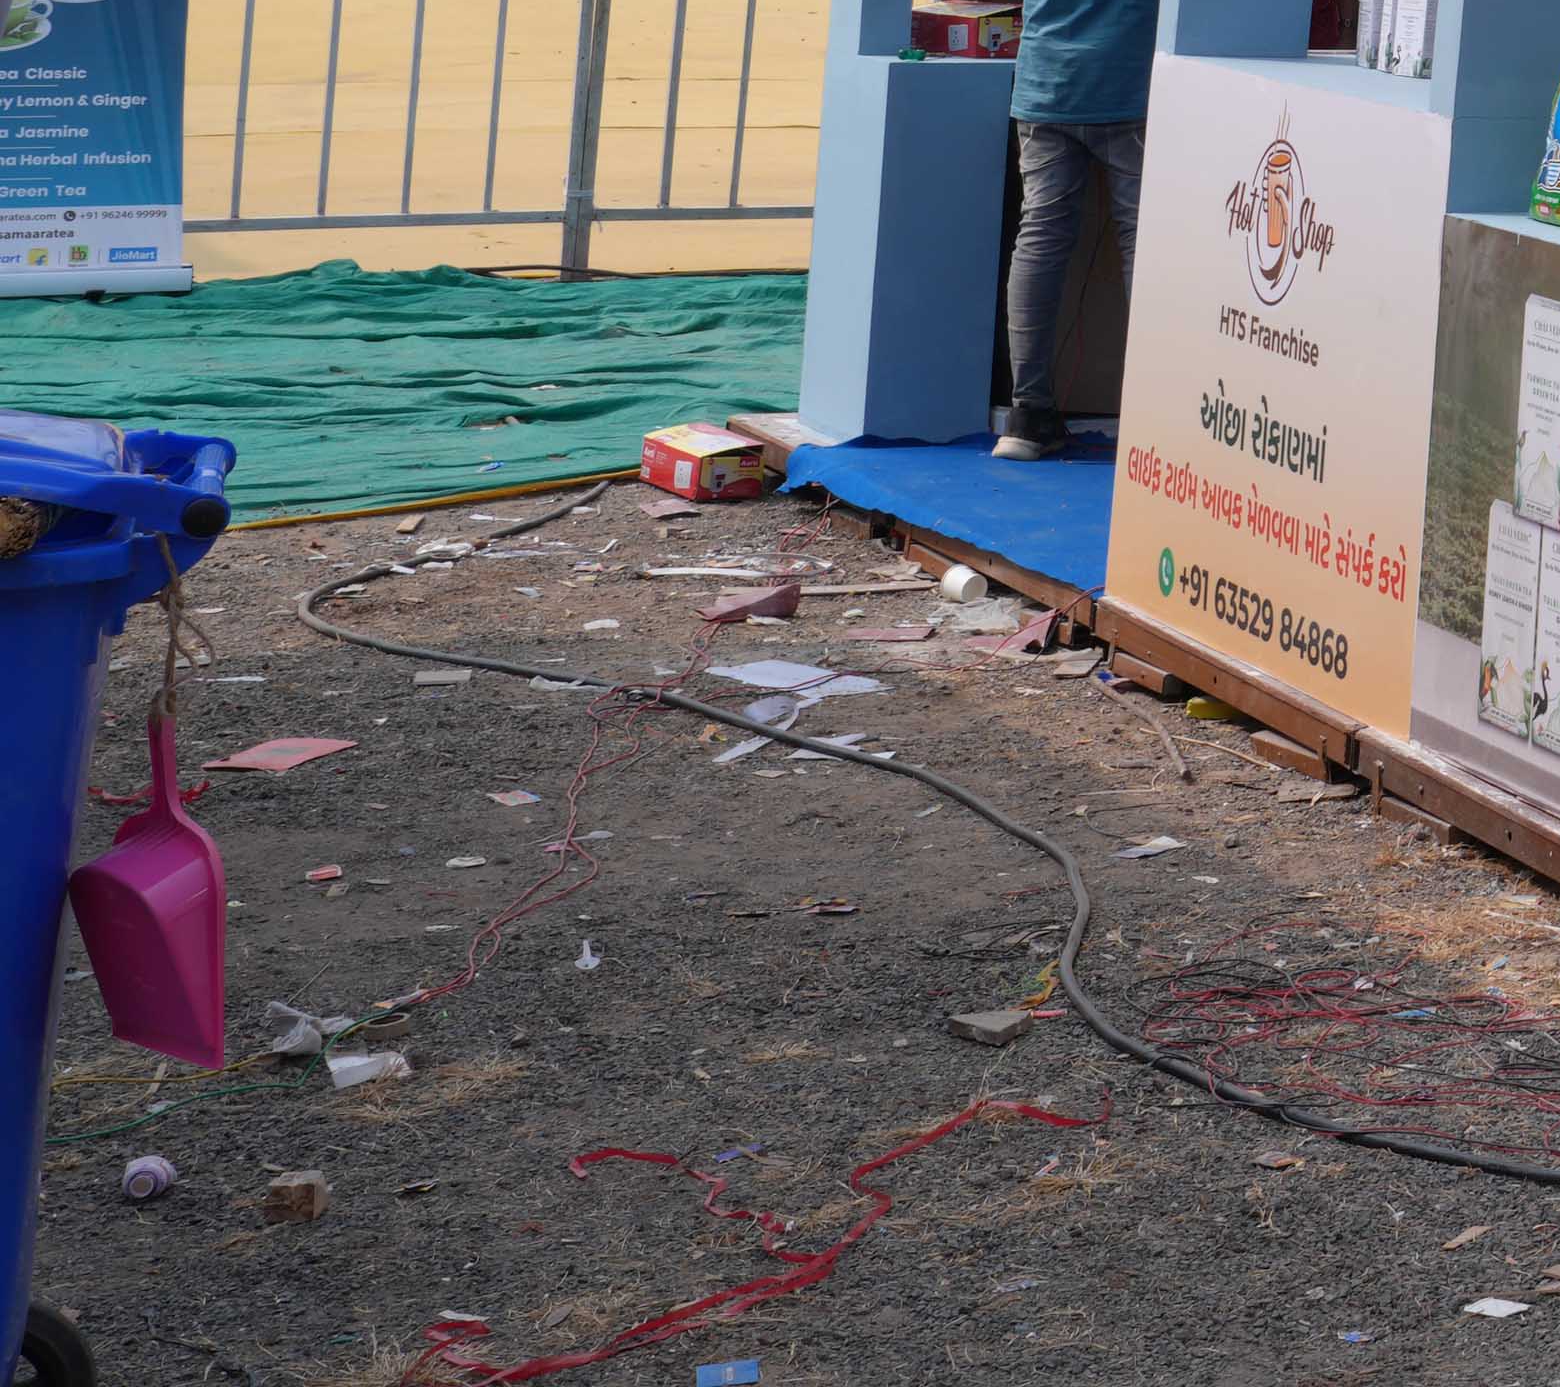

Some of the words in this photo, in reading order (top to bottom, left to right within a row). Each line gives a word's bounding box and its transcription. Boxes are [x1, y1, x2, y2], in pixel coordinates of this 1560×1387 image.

[25, 66, 88, 80] Classic
[16, 94, 74, 107] Lemon
[92, 93, 148, 110] Ginger
[15, 124, 89, 139] Jasmine
[19, 152, 78, 166] Herbal
[83, 150, 152, 165] Infusion
[55, 184, 87, 197] Tea
[101, 210, 134, 220] 96246
[136, 209, 168, 219] 99999
[1225, 180, 1260, 241] Hot
[1292, 196, 1336, 273] Shop
[111, 249, 156, 261] JioMart
[1219, 304, 1246, 344] HTS
[1250, 313, 1320, 368] Franchise
[1200, 378, 1246, 455] ઓછા
[1251, 393, 1327, 485] રોકાણમાં
[1201, 485, 1243, 530] આવક
[1304, 513, 1332, 571] માટે
[1378, 543, 1407, 604] કરો
[1179, 568, 1209, 613] +91
[1214, 576, 1274, 644] 63529
[1280, 611, 1349, 680] 84868
